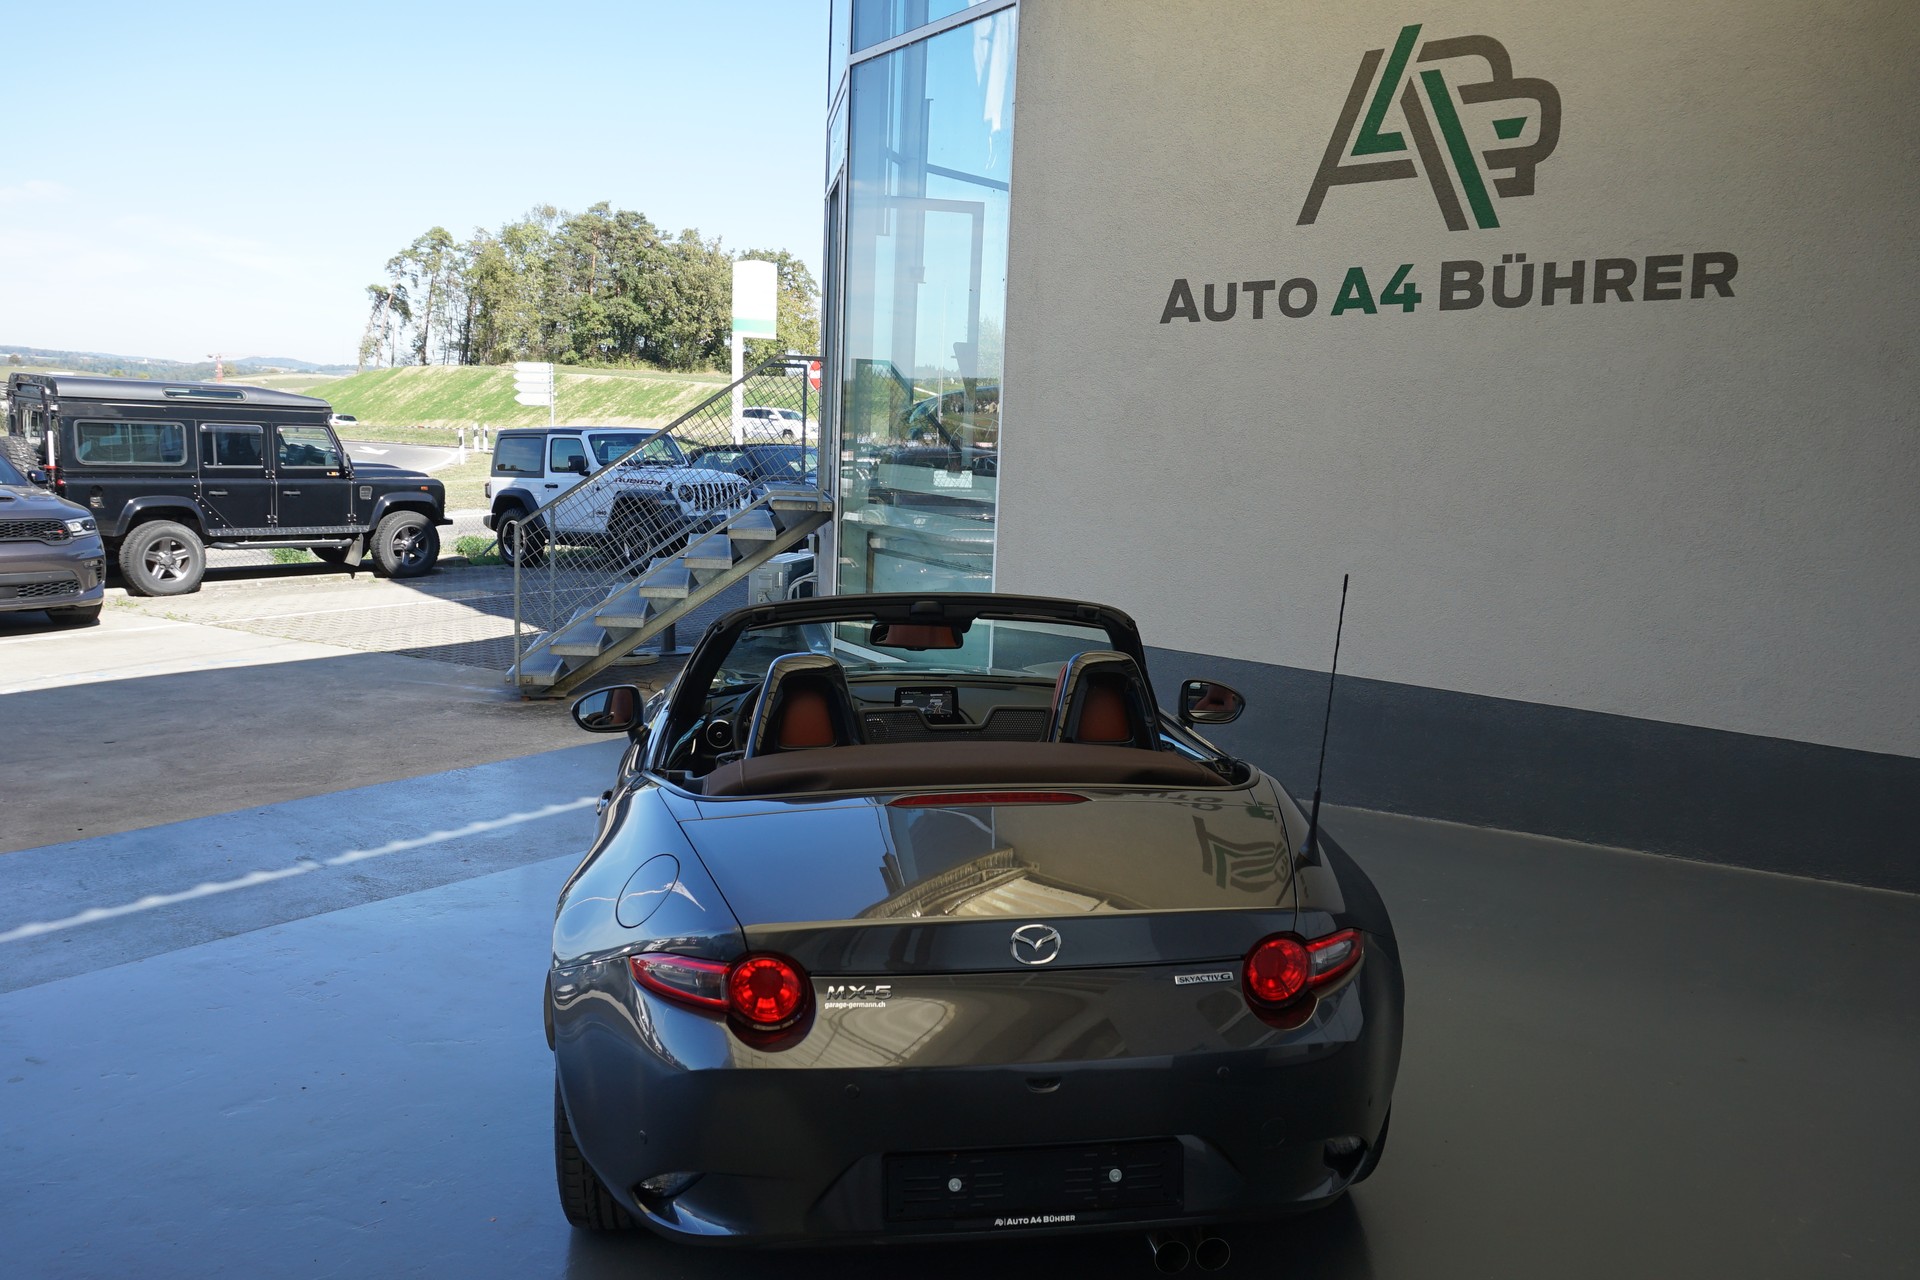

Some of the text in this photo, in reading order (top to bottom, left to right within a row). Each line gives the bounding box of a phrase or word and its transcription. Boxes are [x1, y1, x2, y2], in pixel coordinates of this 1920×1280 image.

[1159, 251, 1739, 324] AUTO A4 BÜHRER
[827, 985, 892, 1000] MX-5
[824, 1001, 886, 1009] garage-germann.ch
[1006, 1217, 1029, 1225] AUTO
[1030, 1215, 1042, 1224] A4
[1043, 1214, 1076, 1223] BÜHRER
